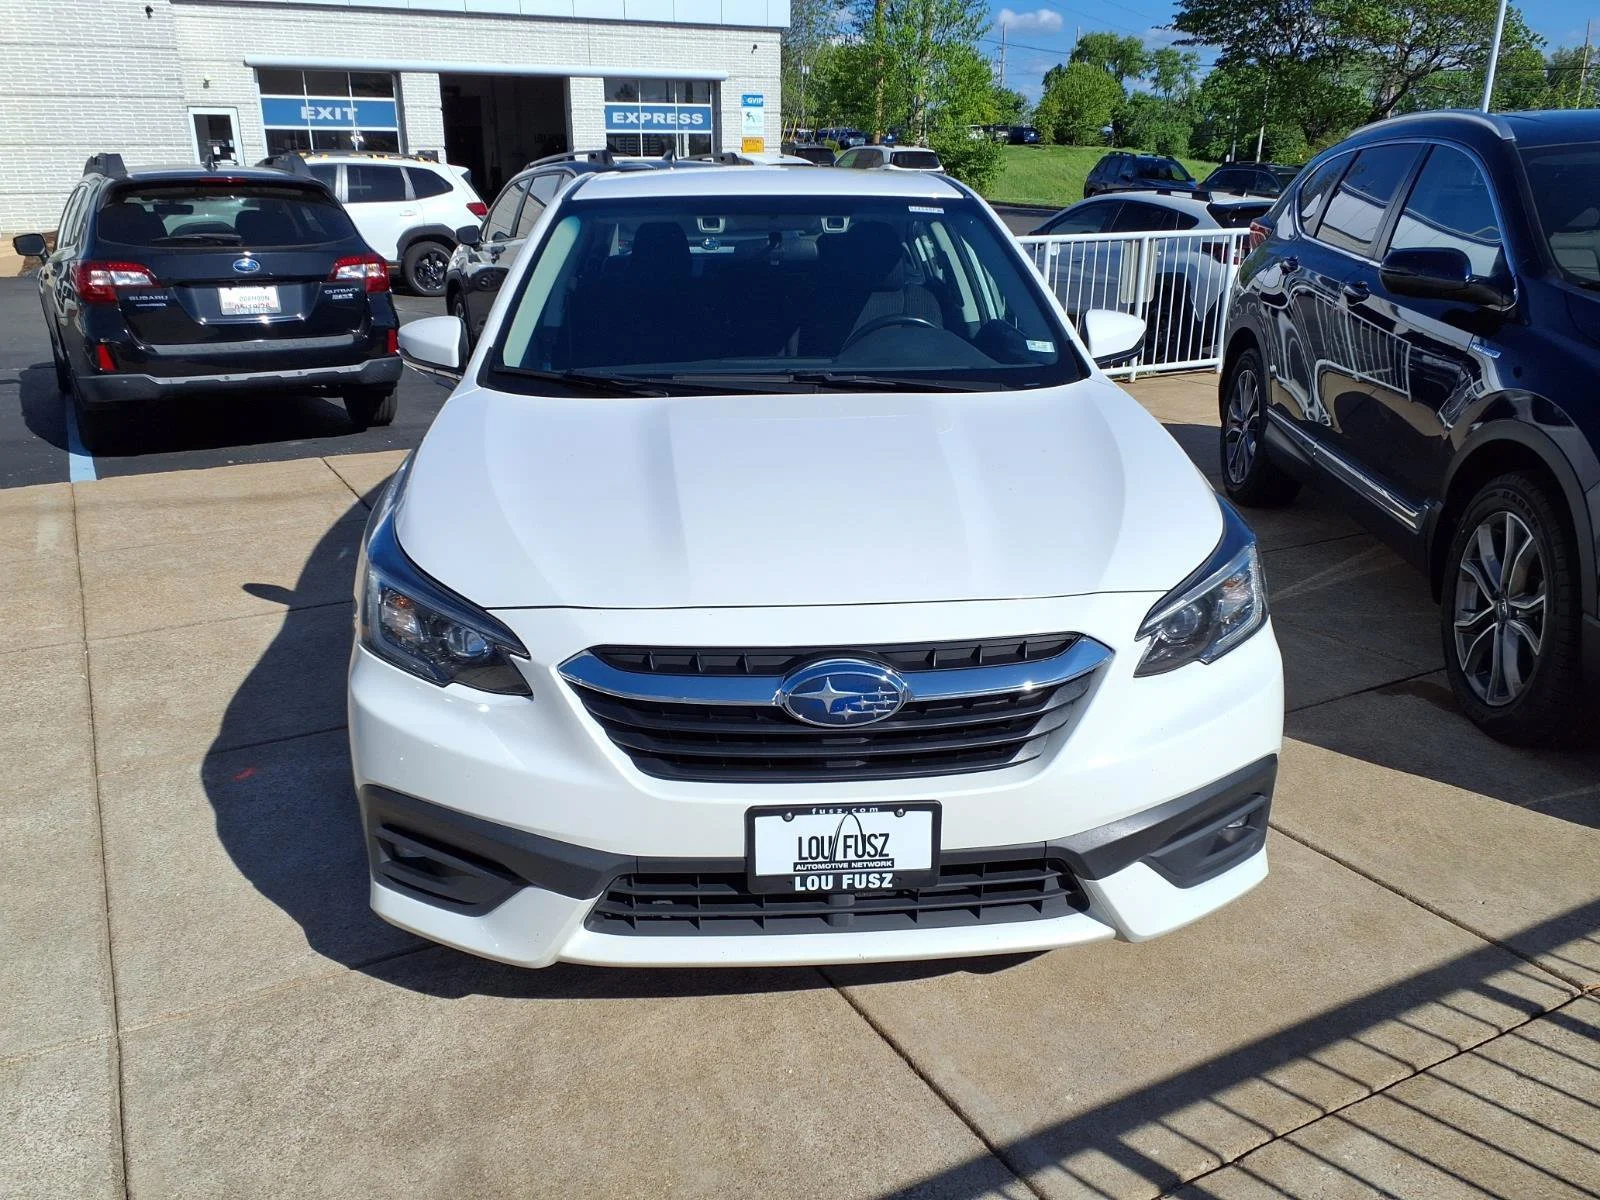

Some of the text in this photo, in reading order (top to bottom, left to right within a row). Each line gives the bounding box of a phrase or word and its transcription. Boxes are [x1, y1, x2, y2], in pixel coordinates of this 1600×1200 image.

[301, 106, 359, 120] EXIT
[612, 112, 703, 124] EXPRESS
[324, 287, 360, 295] OUTBACK
[811, 806, 879, 815] fusz.com
[798, 833, 890, 861] LOU FUSZ
[795, 861, 893, 871] AUTOMOTIVE NETWORK
[794, 873, 894, 892] LOU FUSZ
